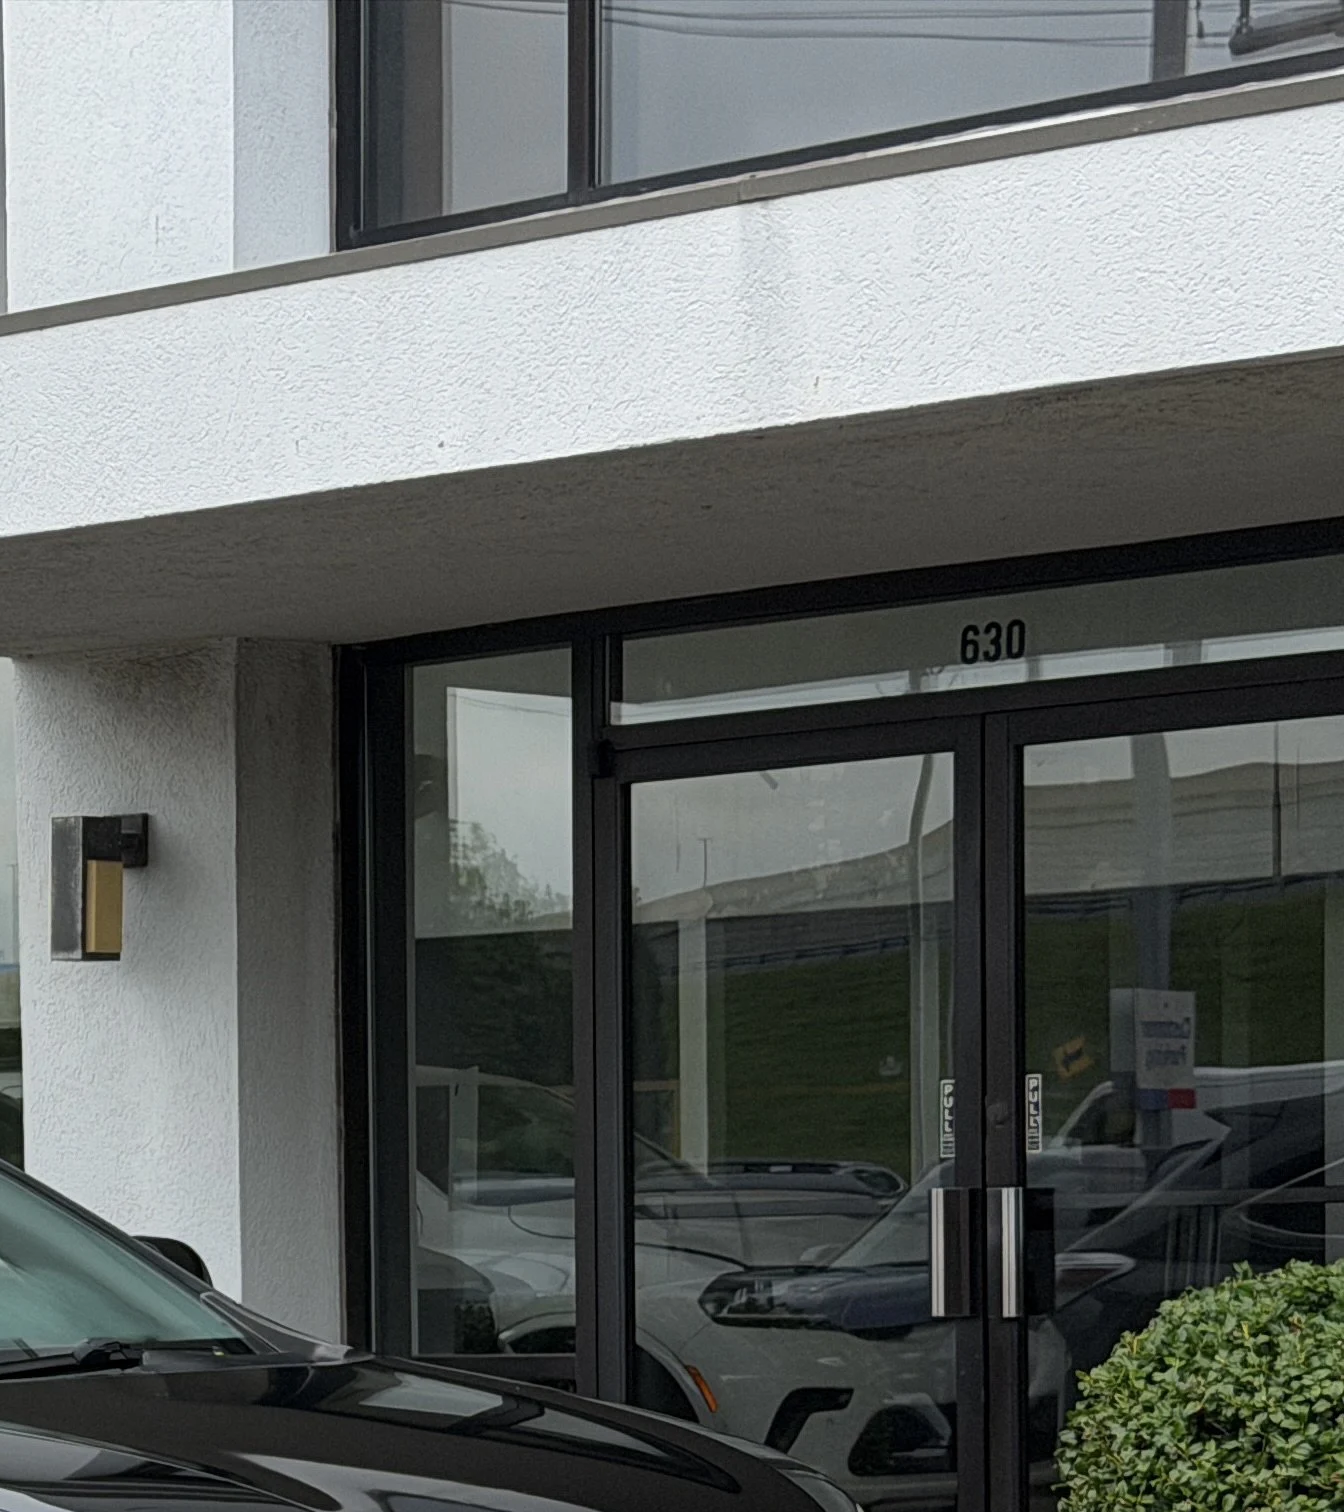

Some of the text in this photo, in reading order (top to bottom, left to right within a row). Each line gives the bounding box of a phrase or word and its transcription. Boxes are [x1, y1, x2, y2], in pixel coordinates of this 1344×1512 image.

[960, 618, 1026, 665] 630
[943, 1083, 954, 1133] PULL
[1028, 1078, 1039, 1128] PULL
